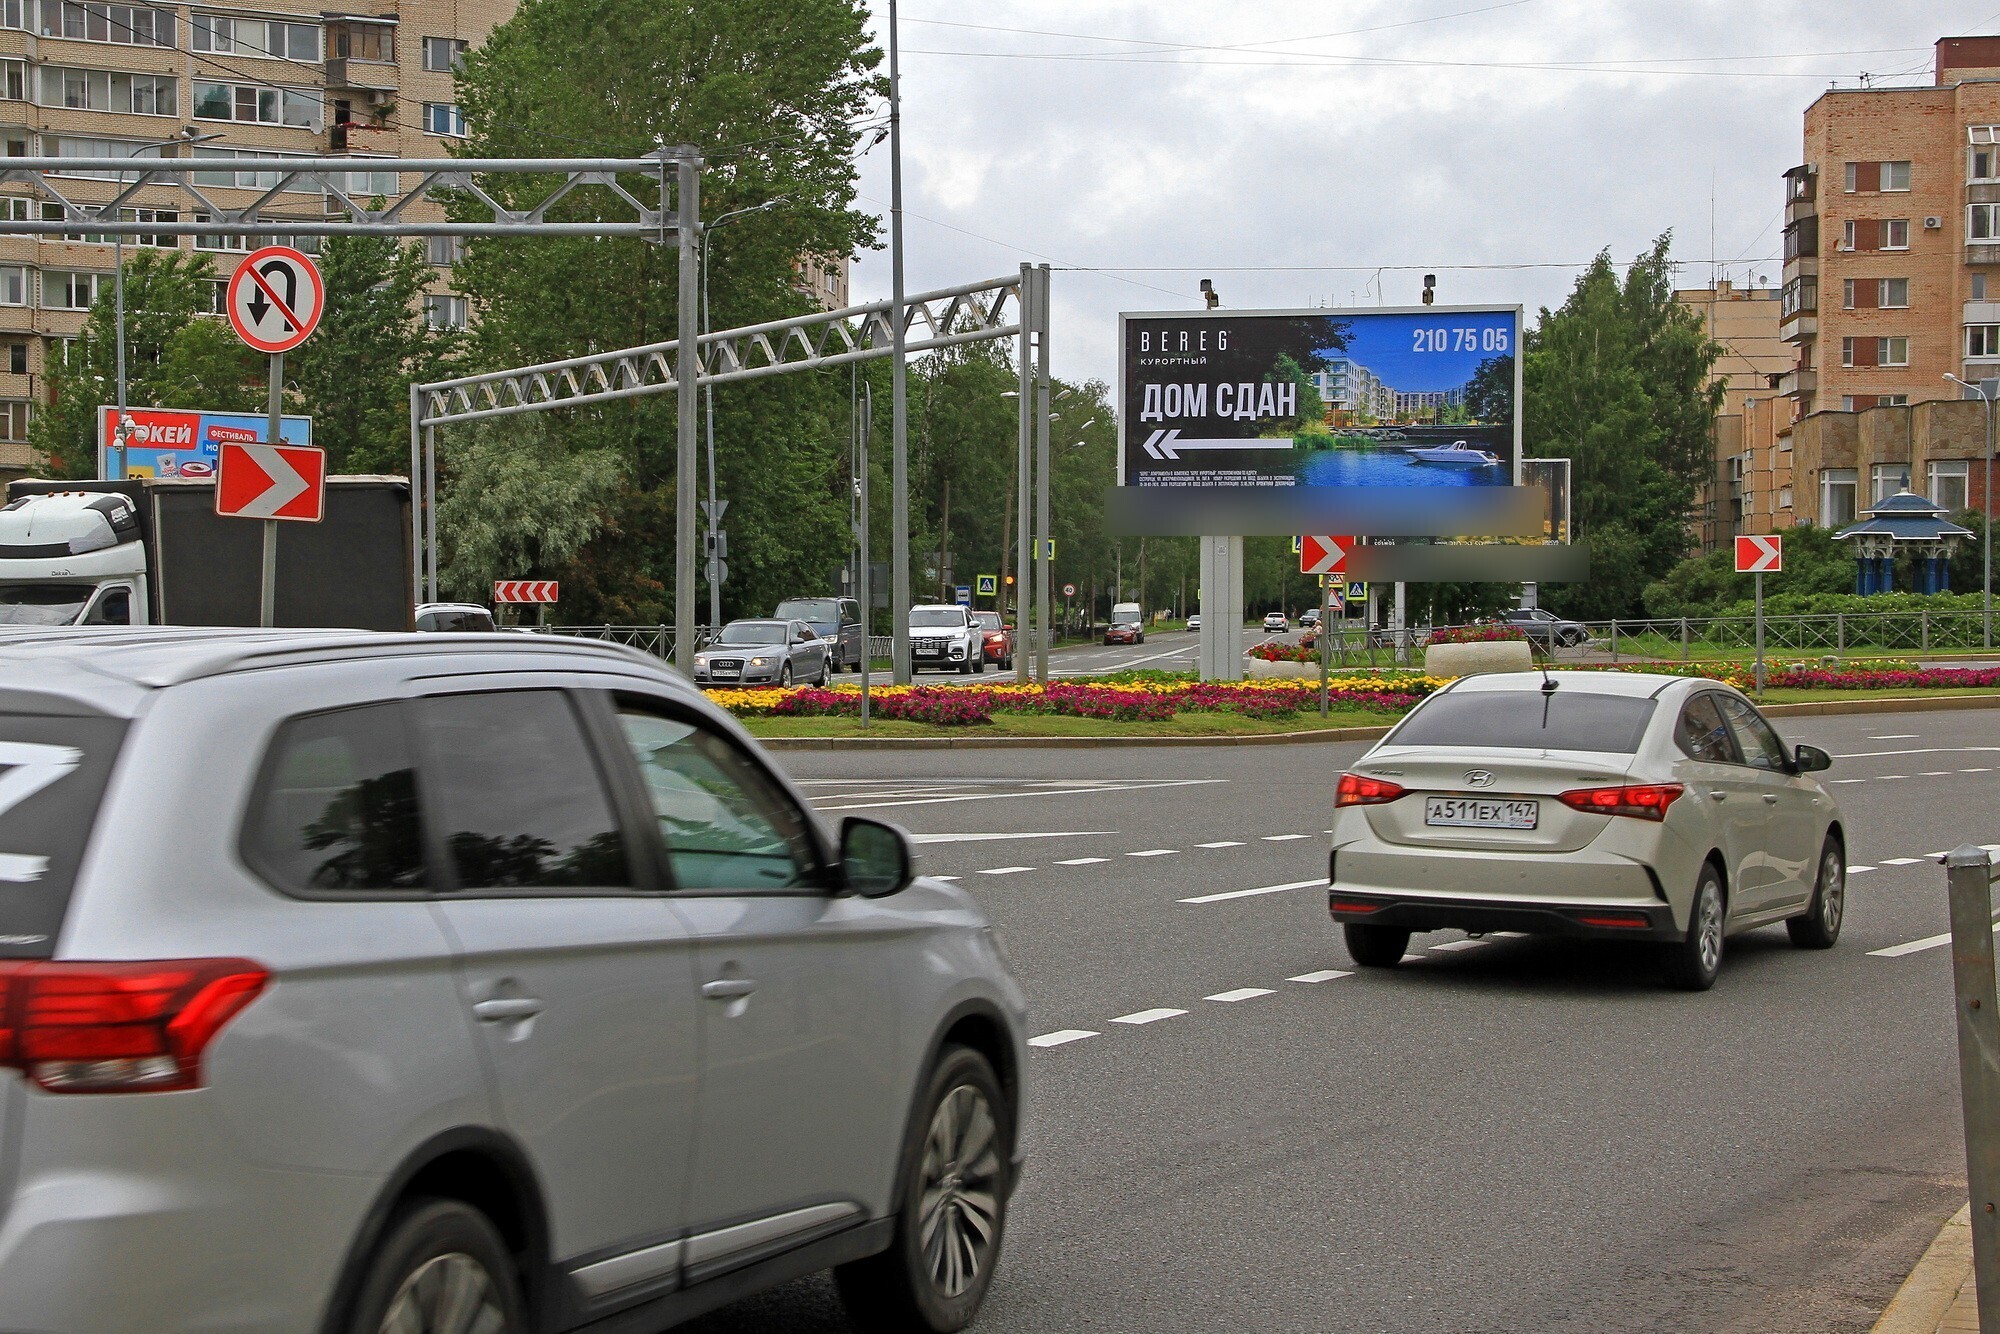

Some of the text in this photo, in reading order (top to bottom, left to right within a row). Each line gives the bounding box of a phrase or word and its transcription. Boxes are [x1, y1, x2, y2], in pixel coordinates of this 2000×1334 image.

[1141, 330, 1227, 352] BEREG
[1412, 327, 1508, 352] 210 75 05
[1140, 356, 1207, 366] КУРОРТНЫЙ
[1140, 382, 1296, 422] ДОМ СДАН
[210, 429, 254, 442] ФЕСТИВАЛЬ
[1506, 802, 1532, 817] 147
